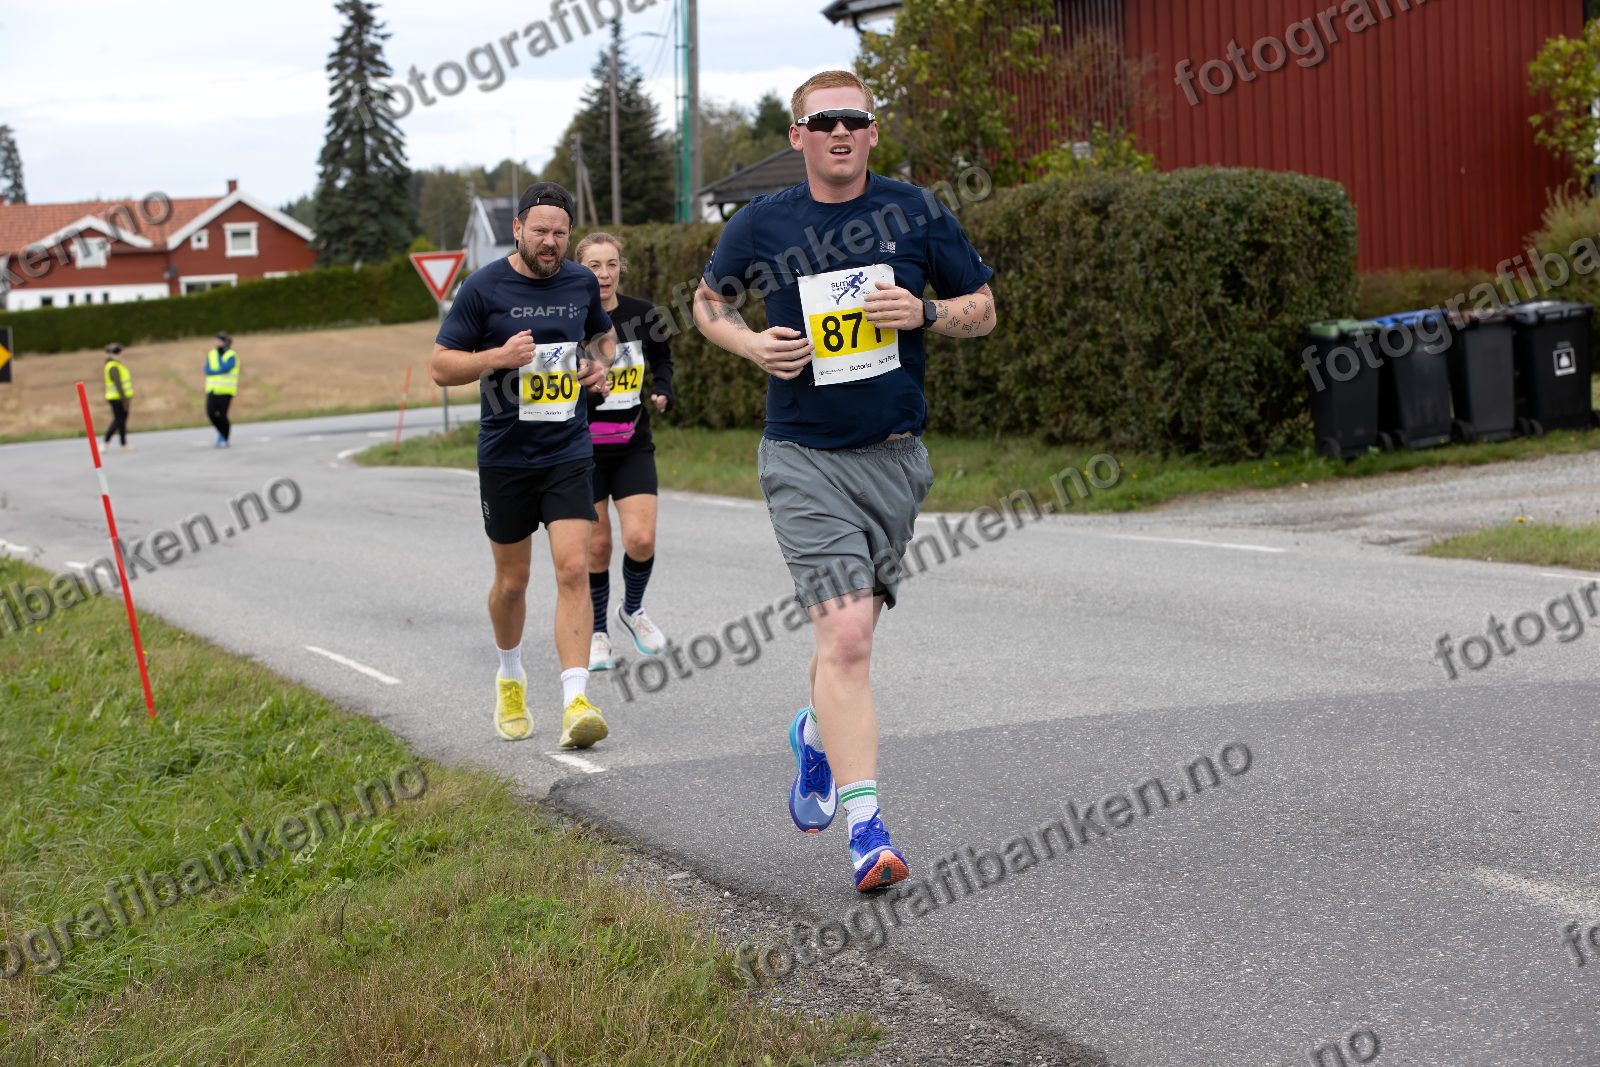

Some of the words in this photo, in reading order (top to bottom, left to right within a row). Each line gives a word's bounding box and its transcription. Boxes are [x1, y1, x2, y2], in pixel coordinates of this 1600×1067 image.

[510, 306, 567, 318] CRAFT
[530, 373, 573, 401] 950
[606, 368, 638, 391] 942
